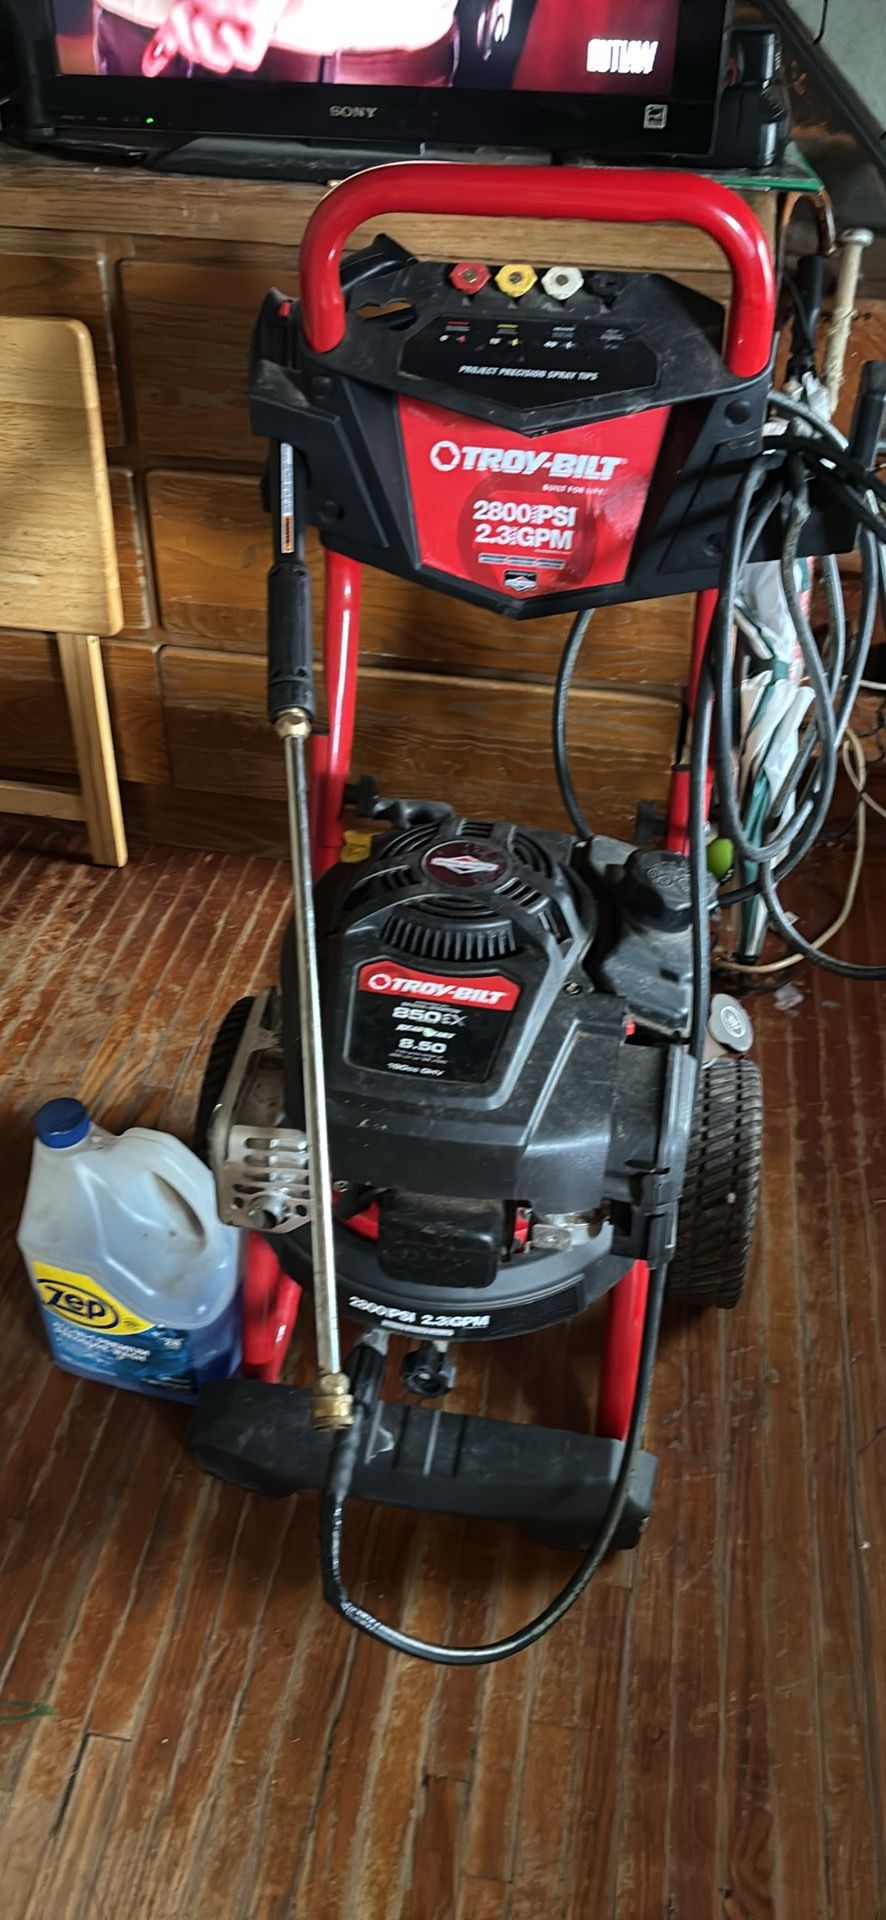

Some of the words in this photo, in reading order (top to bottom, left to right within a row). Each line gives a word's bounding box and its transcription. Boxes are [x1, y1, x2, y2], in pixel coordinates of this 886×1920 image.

[329, 105, 378, 118] SONY
[458, 364, 499, 376] PROJECT
[498, 367, 548, 379] PRECISION
[547, 369, 578, 380] SPRAY
[577, 371, 600, 382] TIPS
[461, 446, 624, 481] TROY-BILT
[472, 499, 531, 524] 2800
[536, 504, 579, 527] PSI
[474, 523, 512, 546] 2.3
[515, 526, 575, 550] GPM
[390, 977, 509, 1005] TROY-BILT
